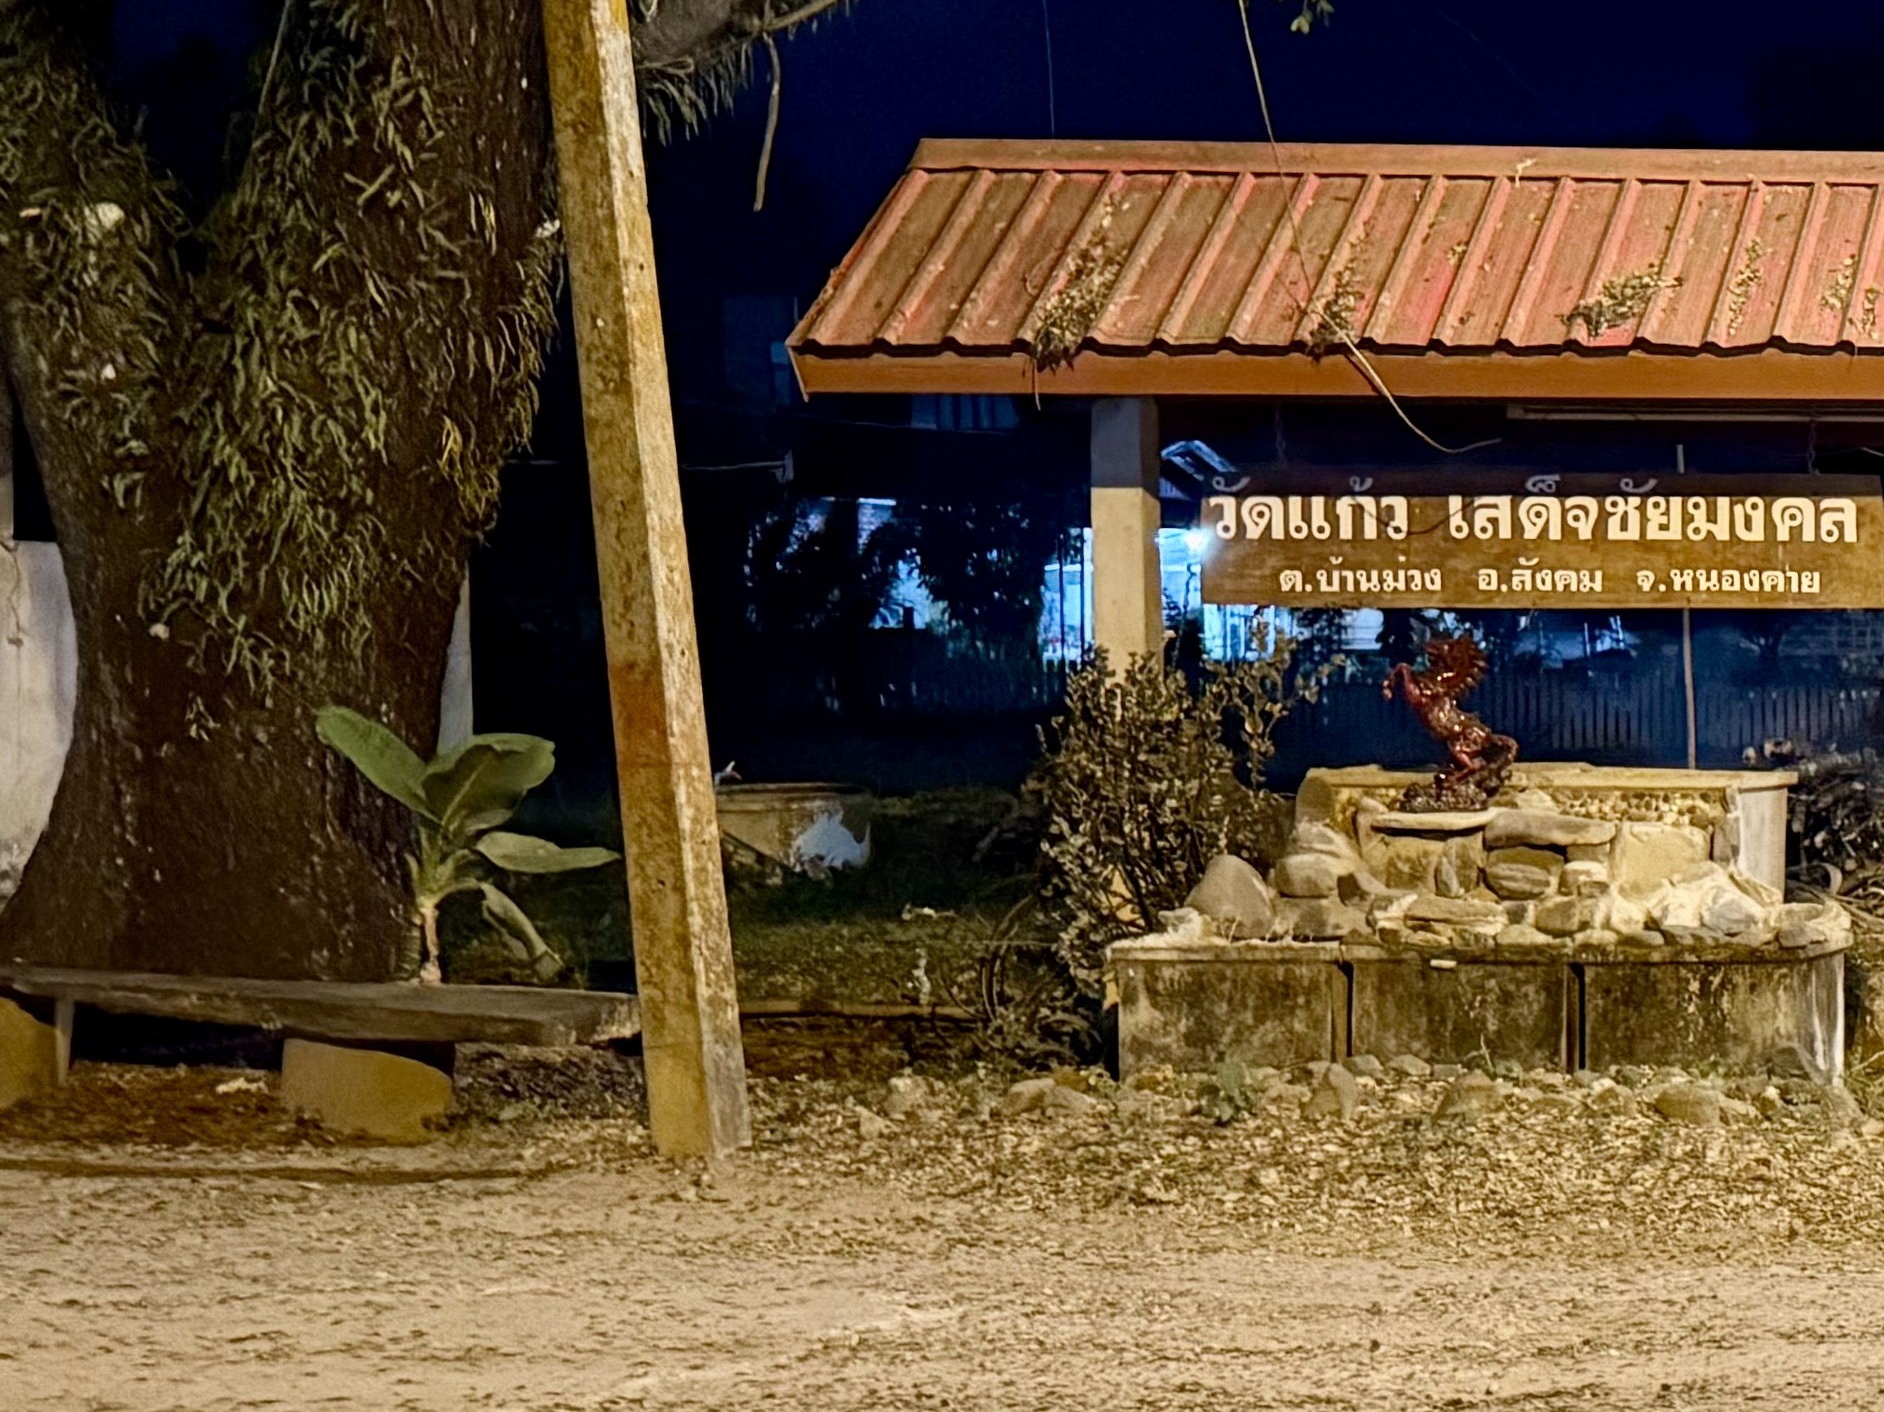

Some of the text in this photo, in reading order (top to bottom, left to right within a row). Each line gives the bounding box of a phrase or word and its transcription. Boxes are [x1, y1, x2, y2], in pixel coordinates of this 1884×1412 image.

[1208, 473, 1859, 543] วัดแก้ว เสด็จชัยมงคล
[1278, 555, 1822, 594] ต.บ้านม่วง อ.สังคม จ.หนองคาย
